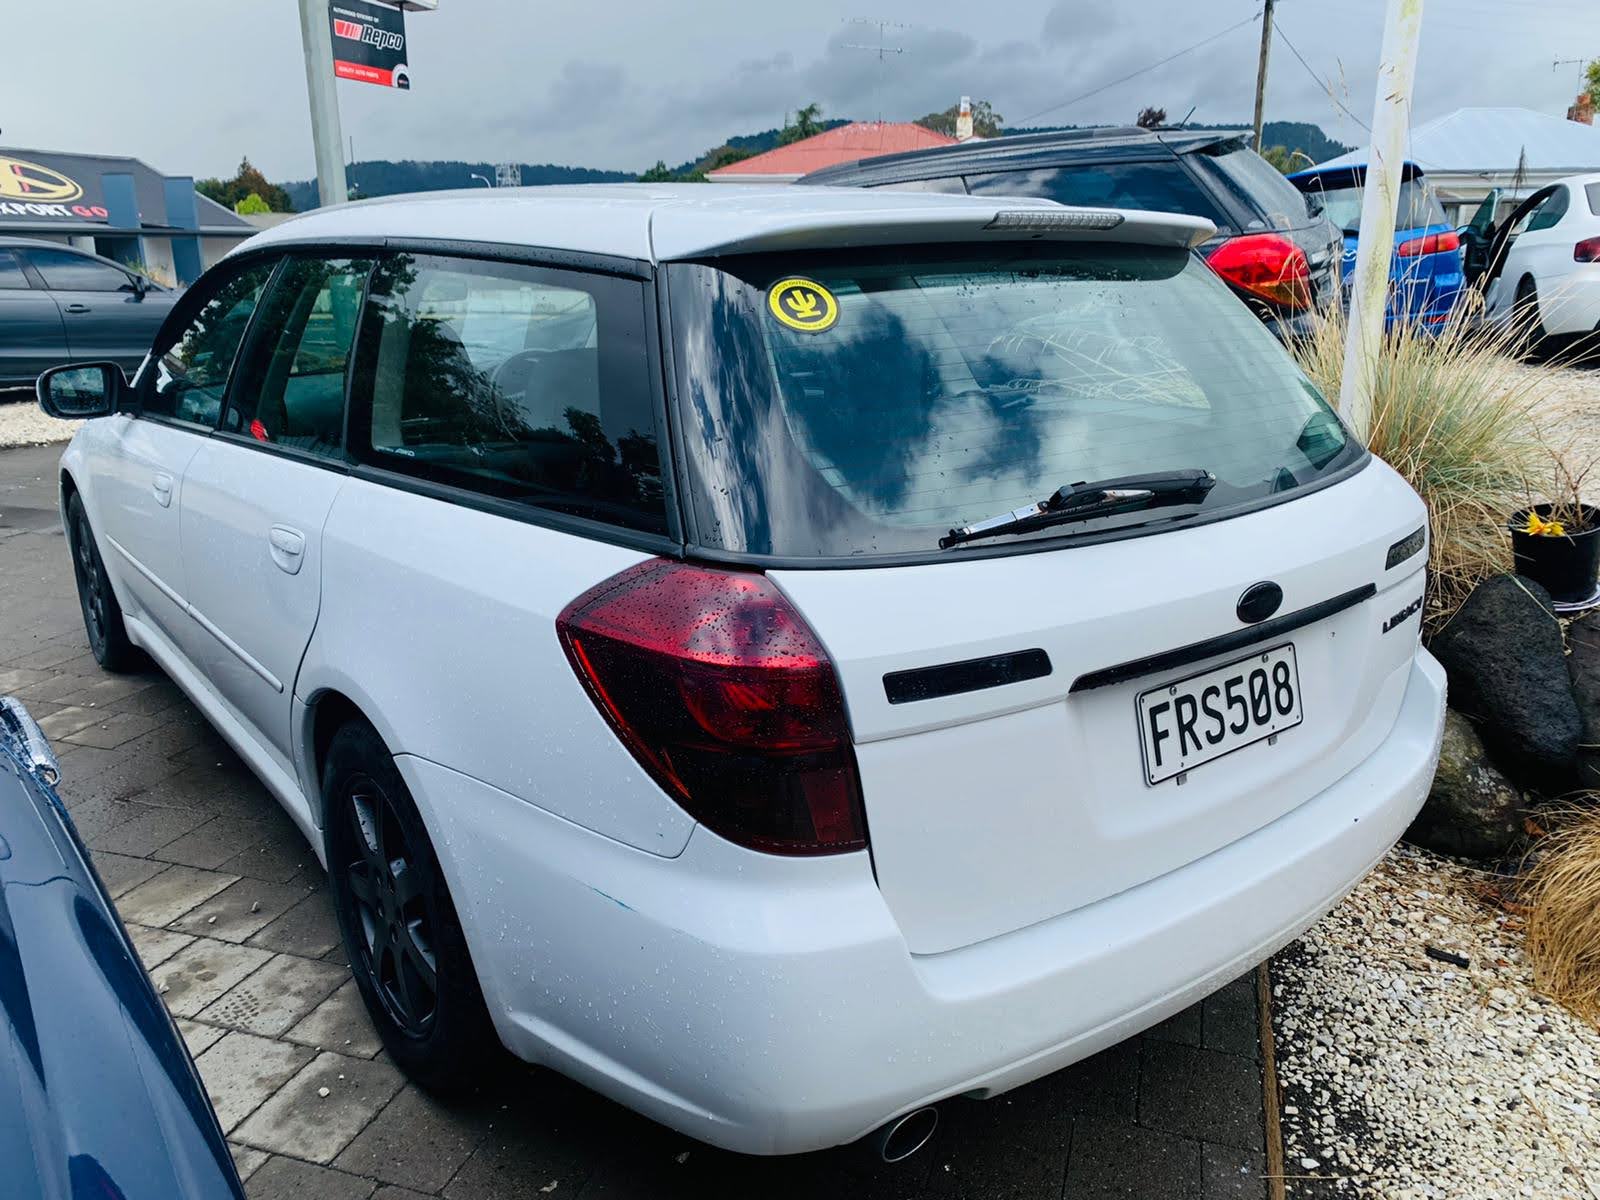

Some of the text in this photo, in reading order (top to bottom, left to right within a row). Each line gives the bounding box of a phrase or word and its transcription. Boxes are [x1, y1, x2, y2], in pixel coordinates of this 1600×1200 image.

[361, 23, 404, 51] Repco
[0, 202, 73, 216] XPORT
[1149, 661, 1294, 766] FRS508
